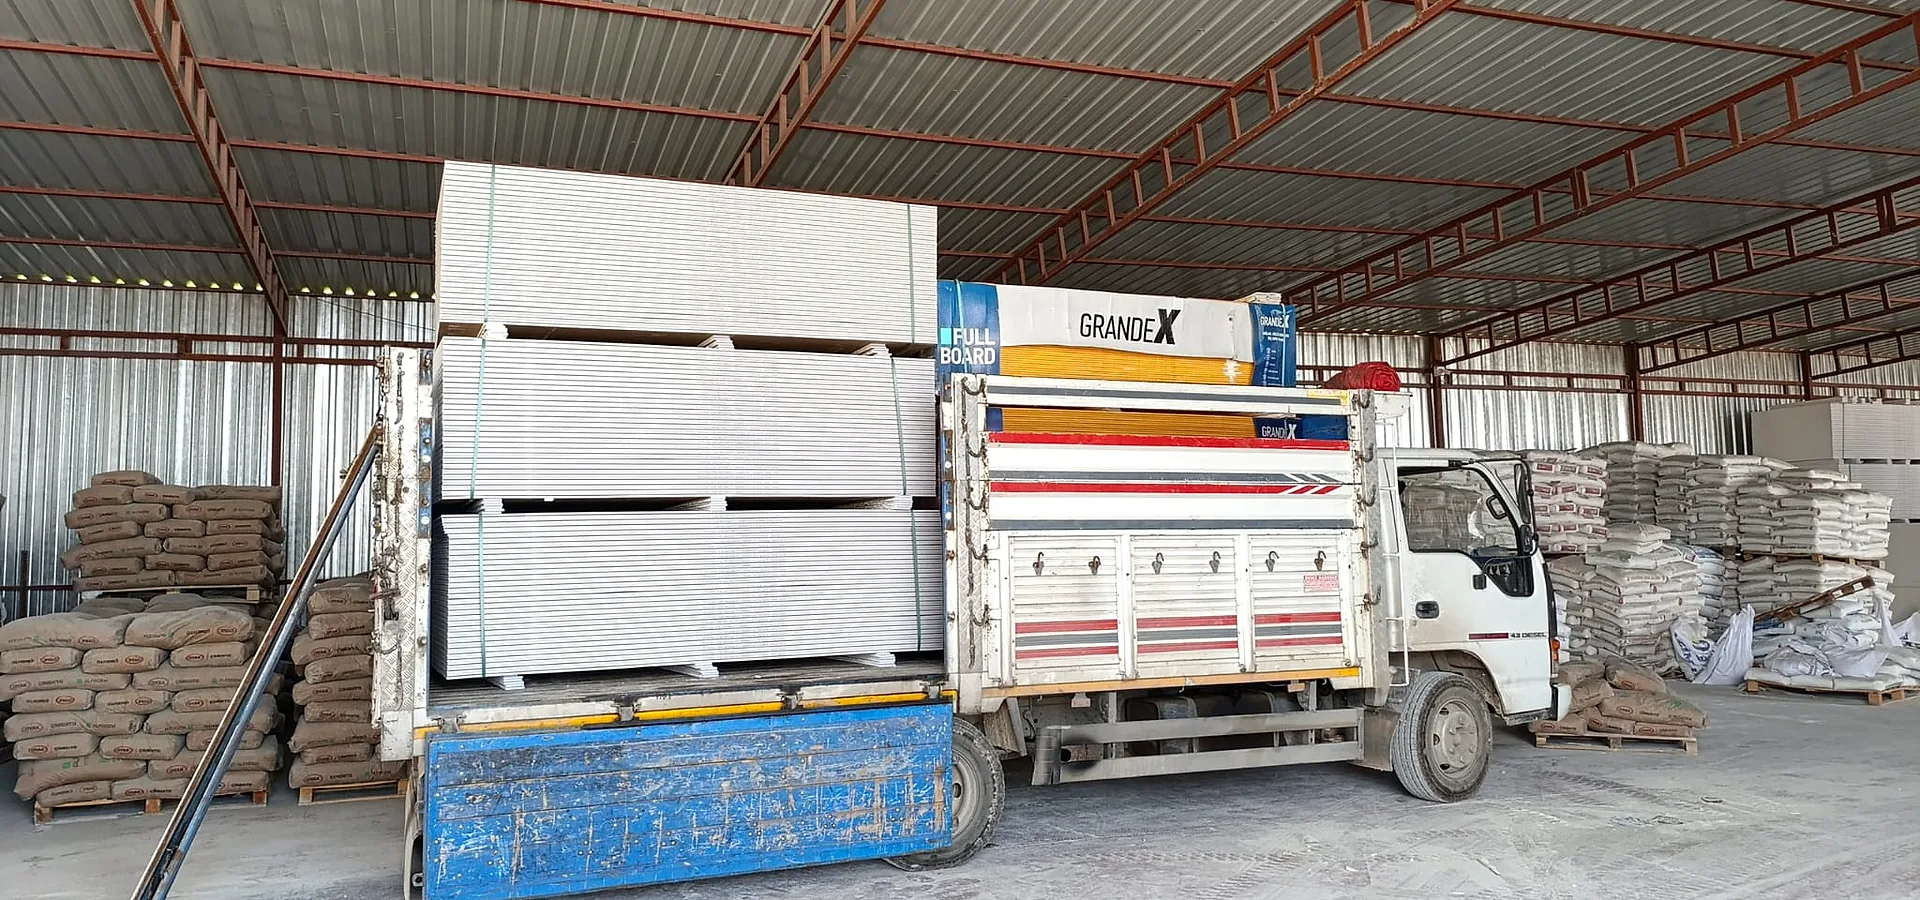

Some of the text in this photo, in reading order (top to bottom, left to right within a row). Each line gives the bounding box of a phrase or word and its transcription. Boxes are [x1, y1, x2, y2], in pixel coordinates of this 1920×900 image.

[1080, 308, 1181, 345] GRANDEX
[1260, 314, 1290, 328] GRANDEX
[953, 327, 996, 346] FULL
[940, 346, 996, 365] BOARD
